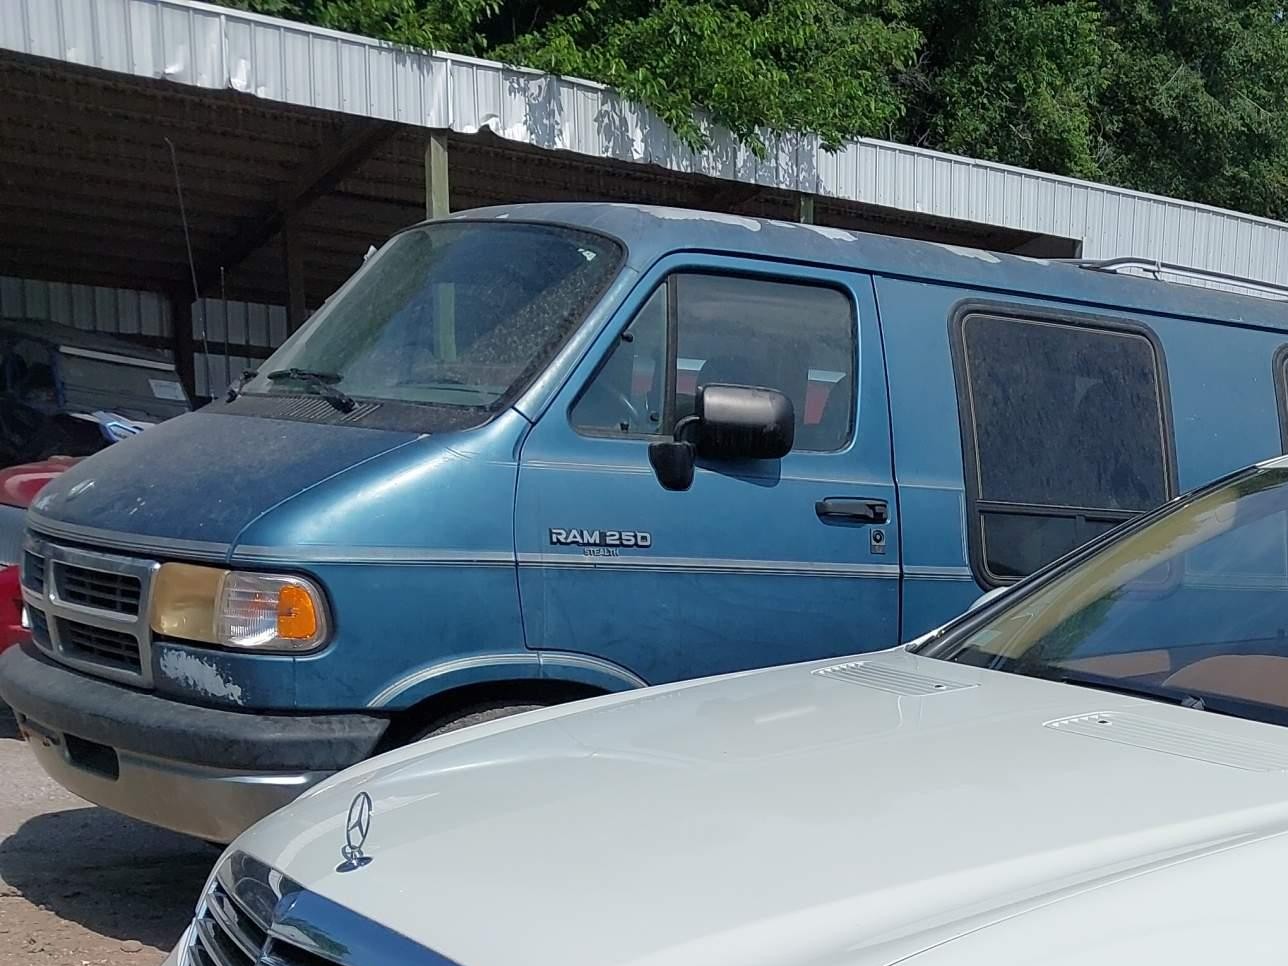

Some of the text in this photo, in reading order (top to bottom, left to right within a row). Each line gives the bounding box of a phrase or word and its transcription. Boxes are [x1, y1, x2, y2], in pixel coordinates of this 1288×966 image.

[550, 528, 653, 548] RAM 250
[584, 547, 619, 557] STEALTH
